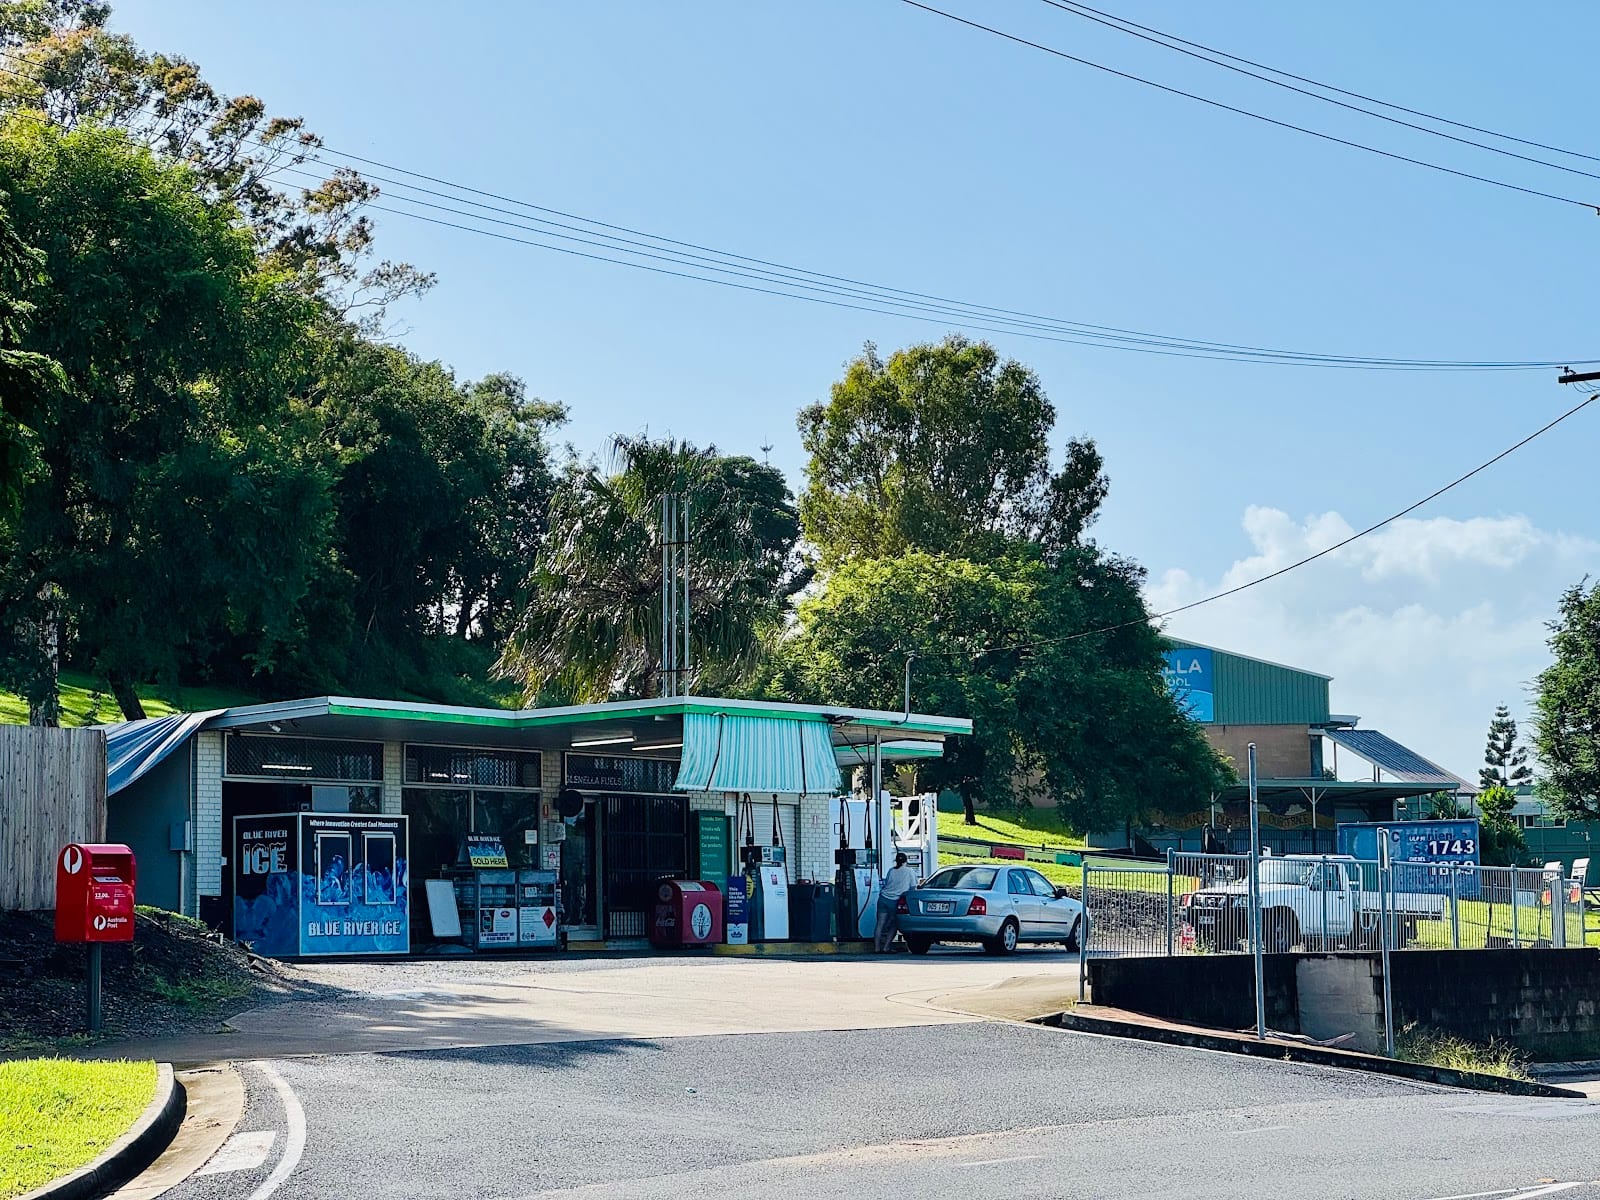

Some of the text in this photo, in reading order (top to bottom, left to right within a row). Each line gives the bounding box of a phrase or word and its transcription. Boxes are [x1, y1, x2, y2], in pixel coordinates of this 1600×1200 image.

[1165, 678, 1191, 687] OOL
[310, 819, 325, 827] Where
[243, 829, 288, 839] BLUE RIVER
[243, 842, 288, 875] ICE
[473, 857, 507, 865] SOLD HERE
[308, 920, 401, 936] BLUE RIVER ICE
